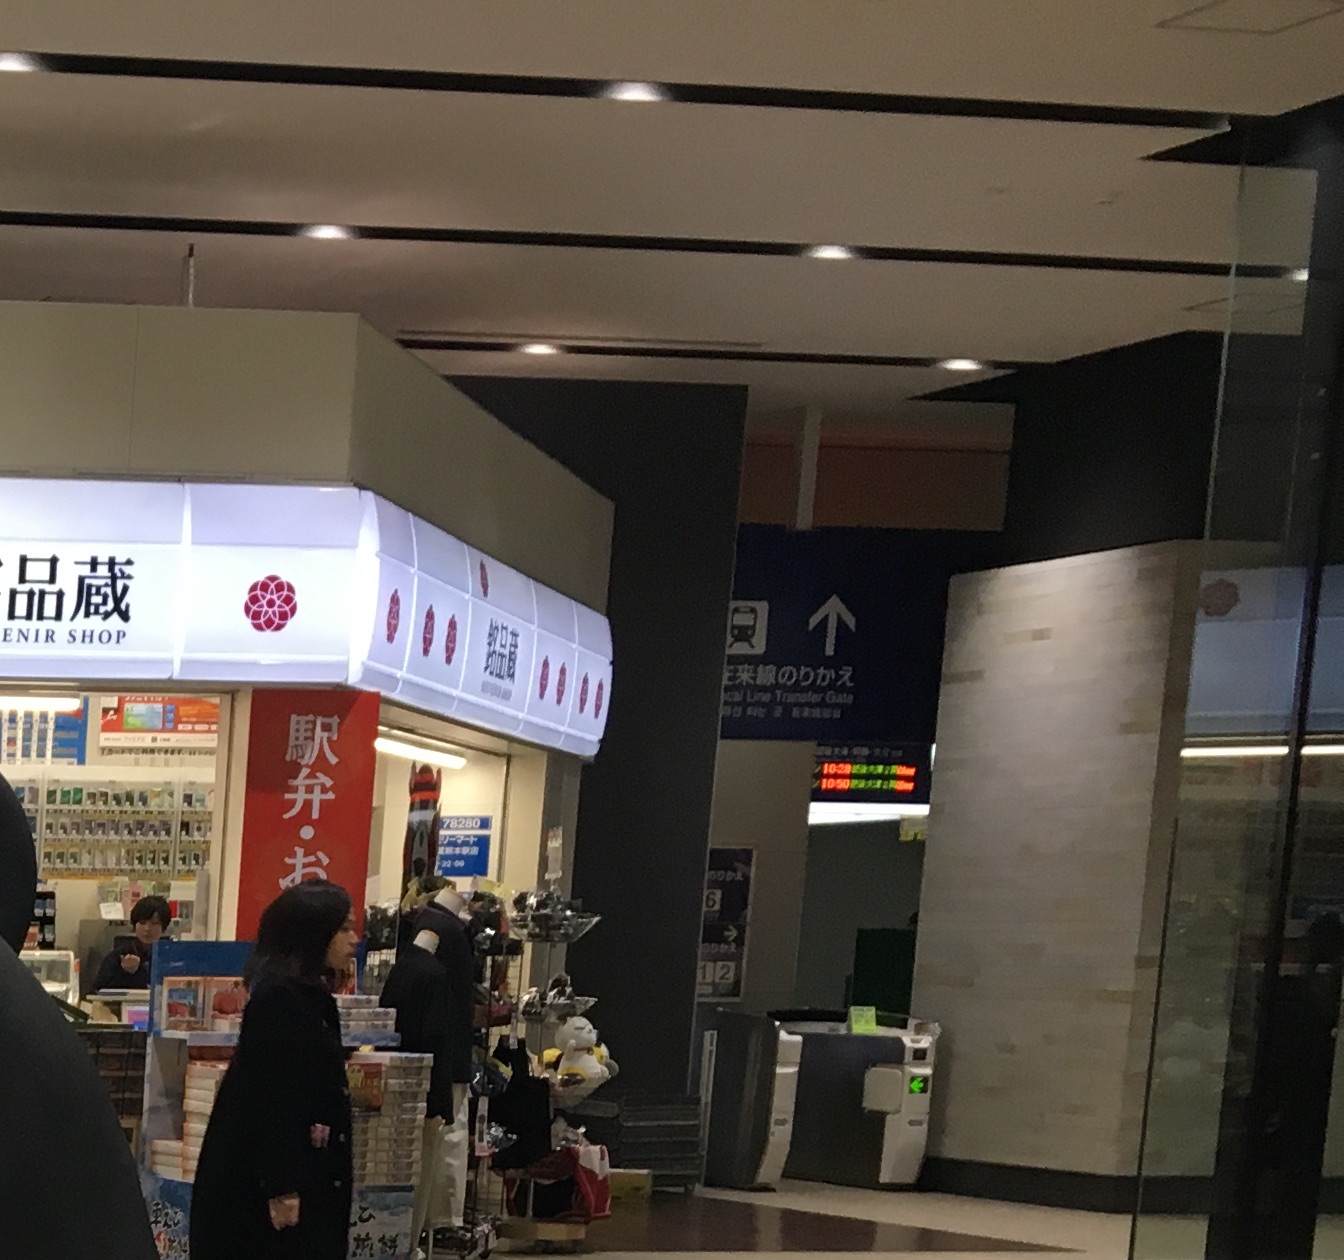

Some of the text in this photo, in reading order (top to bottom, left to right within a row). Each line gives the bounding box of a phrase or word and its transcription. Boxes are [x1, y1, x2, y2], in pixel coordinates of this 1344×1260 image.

[67, 628, 127, 645] SHOP
[483, 617, 520, 683] 銘品蔵
